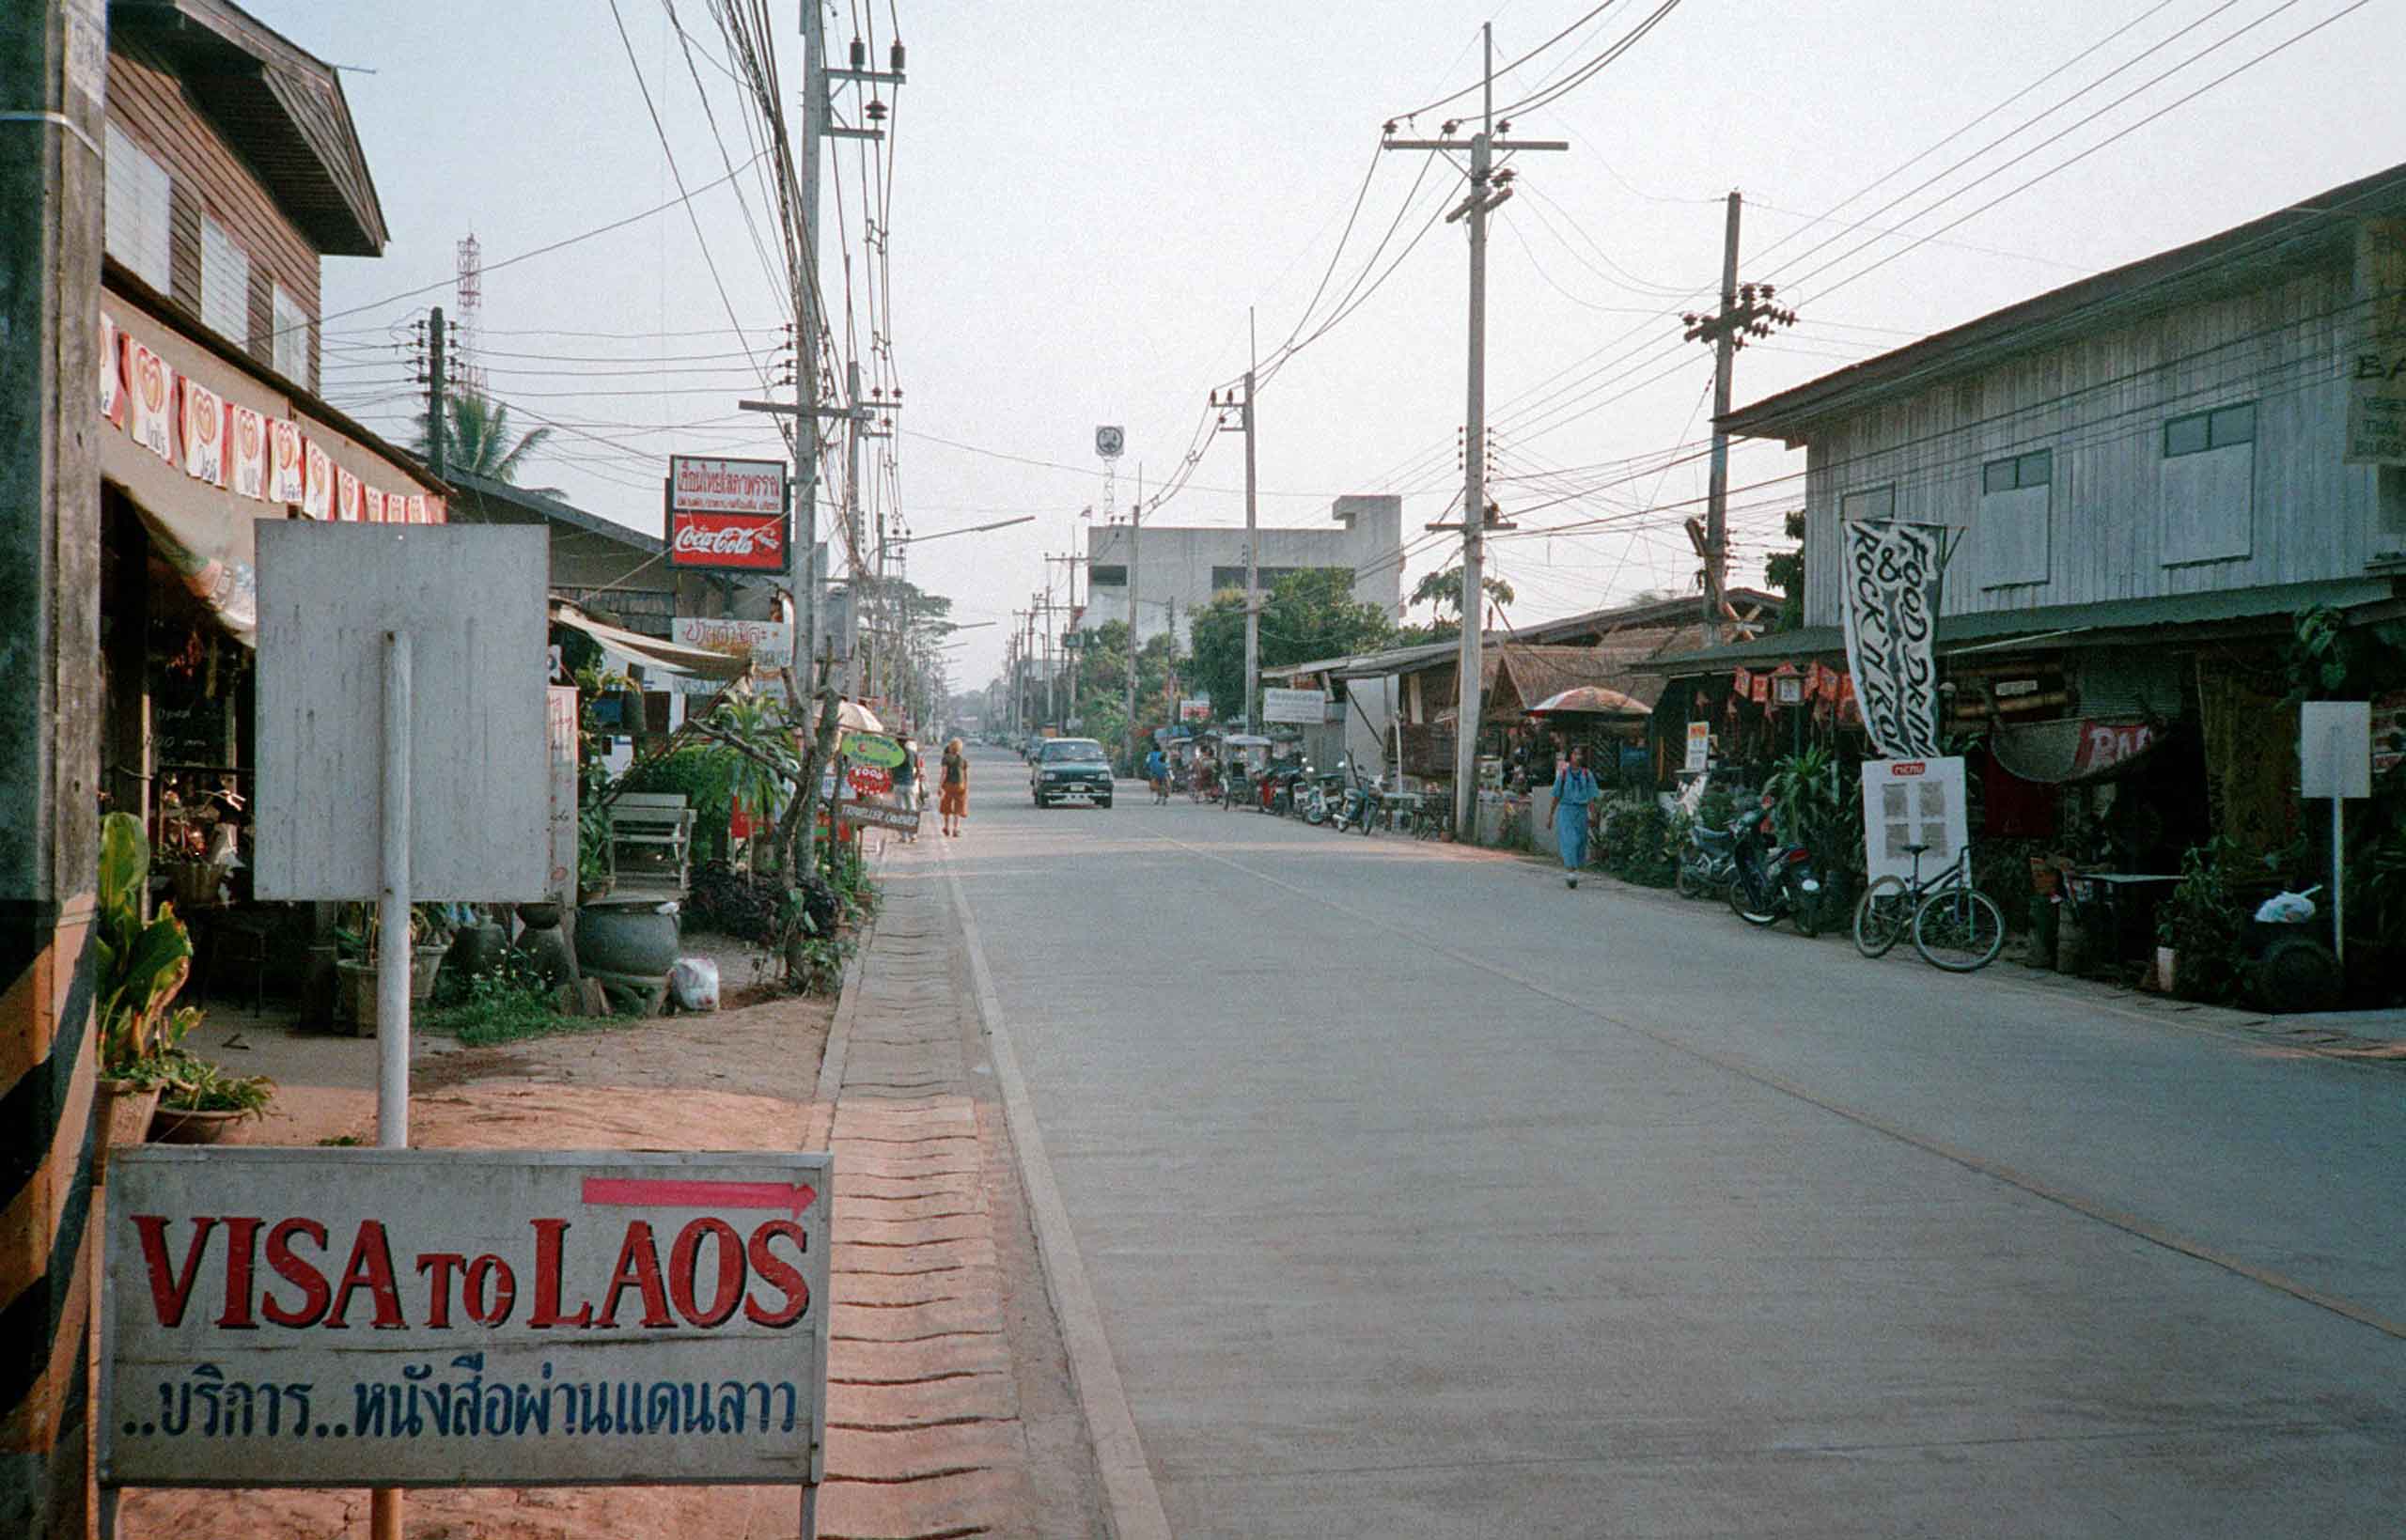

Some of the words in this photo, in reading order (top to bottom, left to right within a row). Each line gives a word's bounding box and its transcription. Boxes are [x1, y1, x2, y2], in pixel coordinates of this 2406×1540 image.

[675, 525, 755, 554] Coca-Cola
[1897, 528, 1929, 643] FOOD
[1902, 643, 1943, 758] DRIN
[130, 1216, 411, 1330] VISA
[527, 1216, 811, 1330] LAOS
